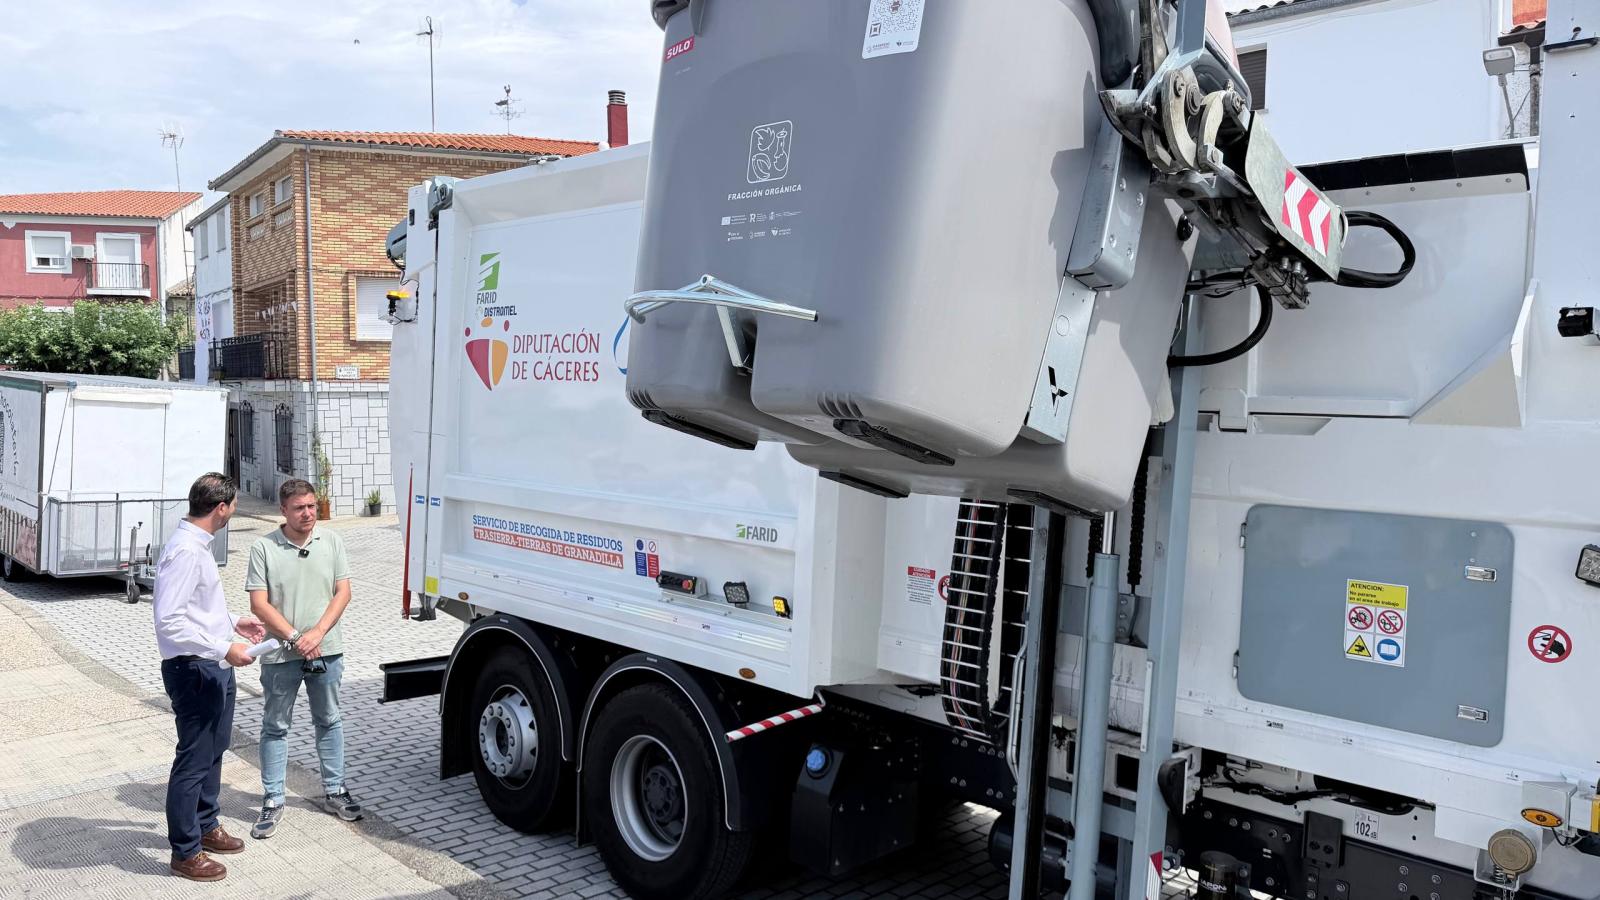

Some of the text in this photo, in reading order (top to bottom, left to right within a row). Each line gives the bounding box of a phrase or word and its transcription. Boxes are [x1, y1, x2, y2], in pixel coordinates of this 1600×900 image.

[666, 39, 691, 60] SULO
[764, 184, 802, 196] ORGÁNICA
[476, 291, 497, 304] FARID
[484, 305, 517, 317] DISTROMEL
[513, 328, 600, 354] DIPUTACIÓN
[512, 355, 599, 382] DE CÁCERES
[472, 514, 623, 552] SERVICIO DE RECOGIDA DE RESIDUOS
[746, 525, 778, 543] FARID
[474, 528, 551, 553] TRASIERRA-TIERRAS
[551, 543, 564, 556] DE
[563, 545, 623, 568] GRANADILLA
[1355, 821, 1371, 837] 102
